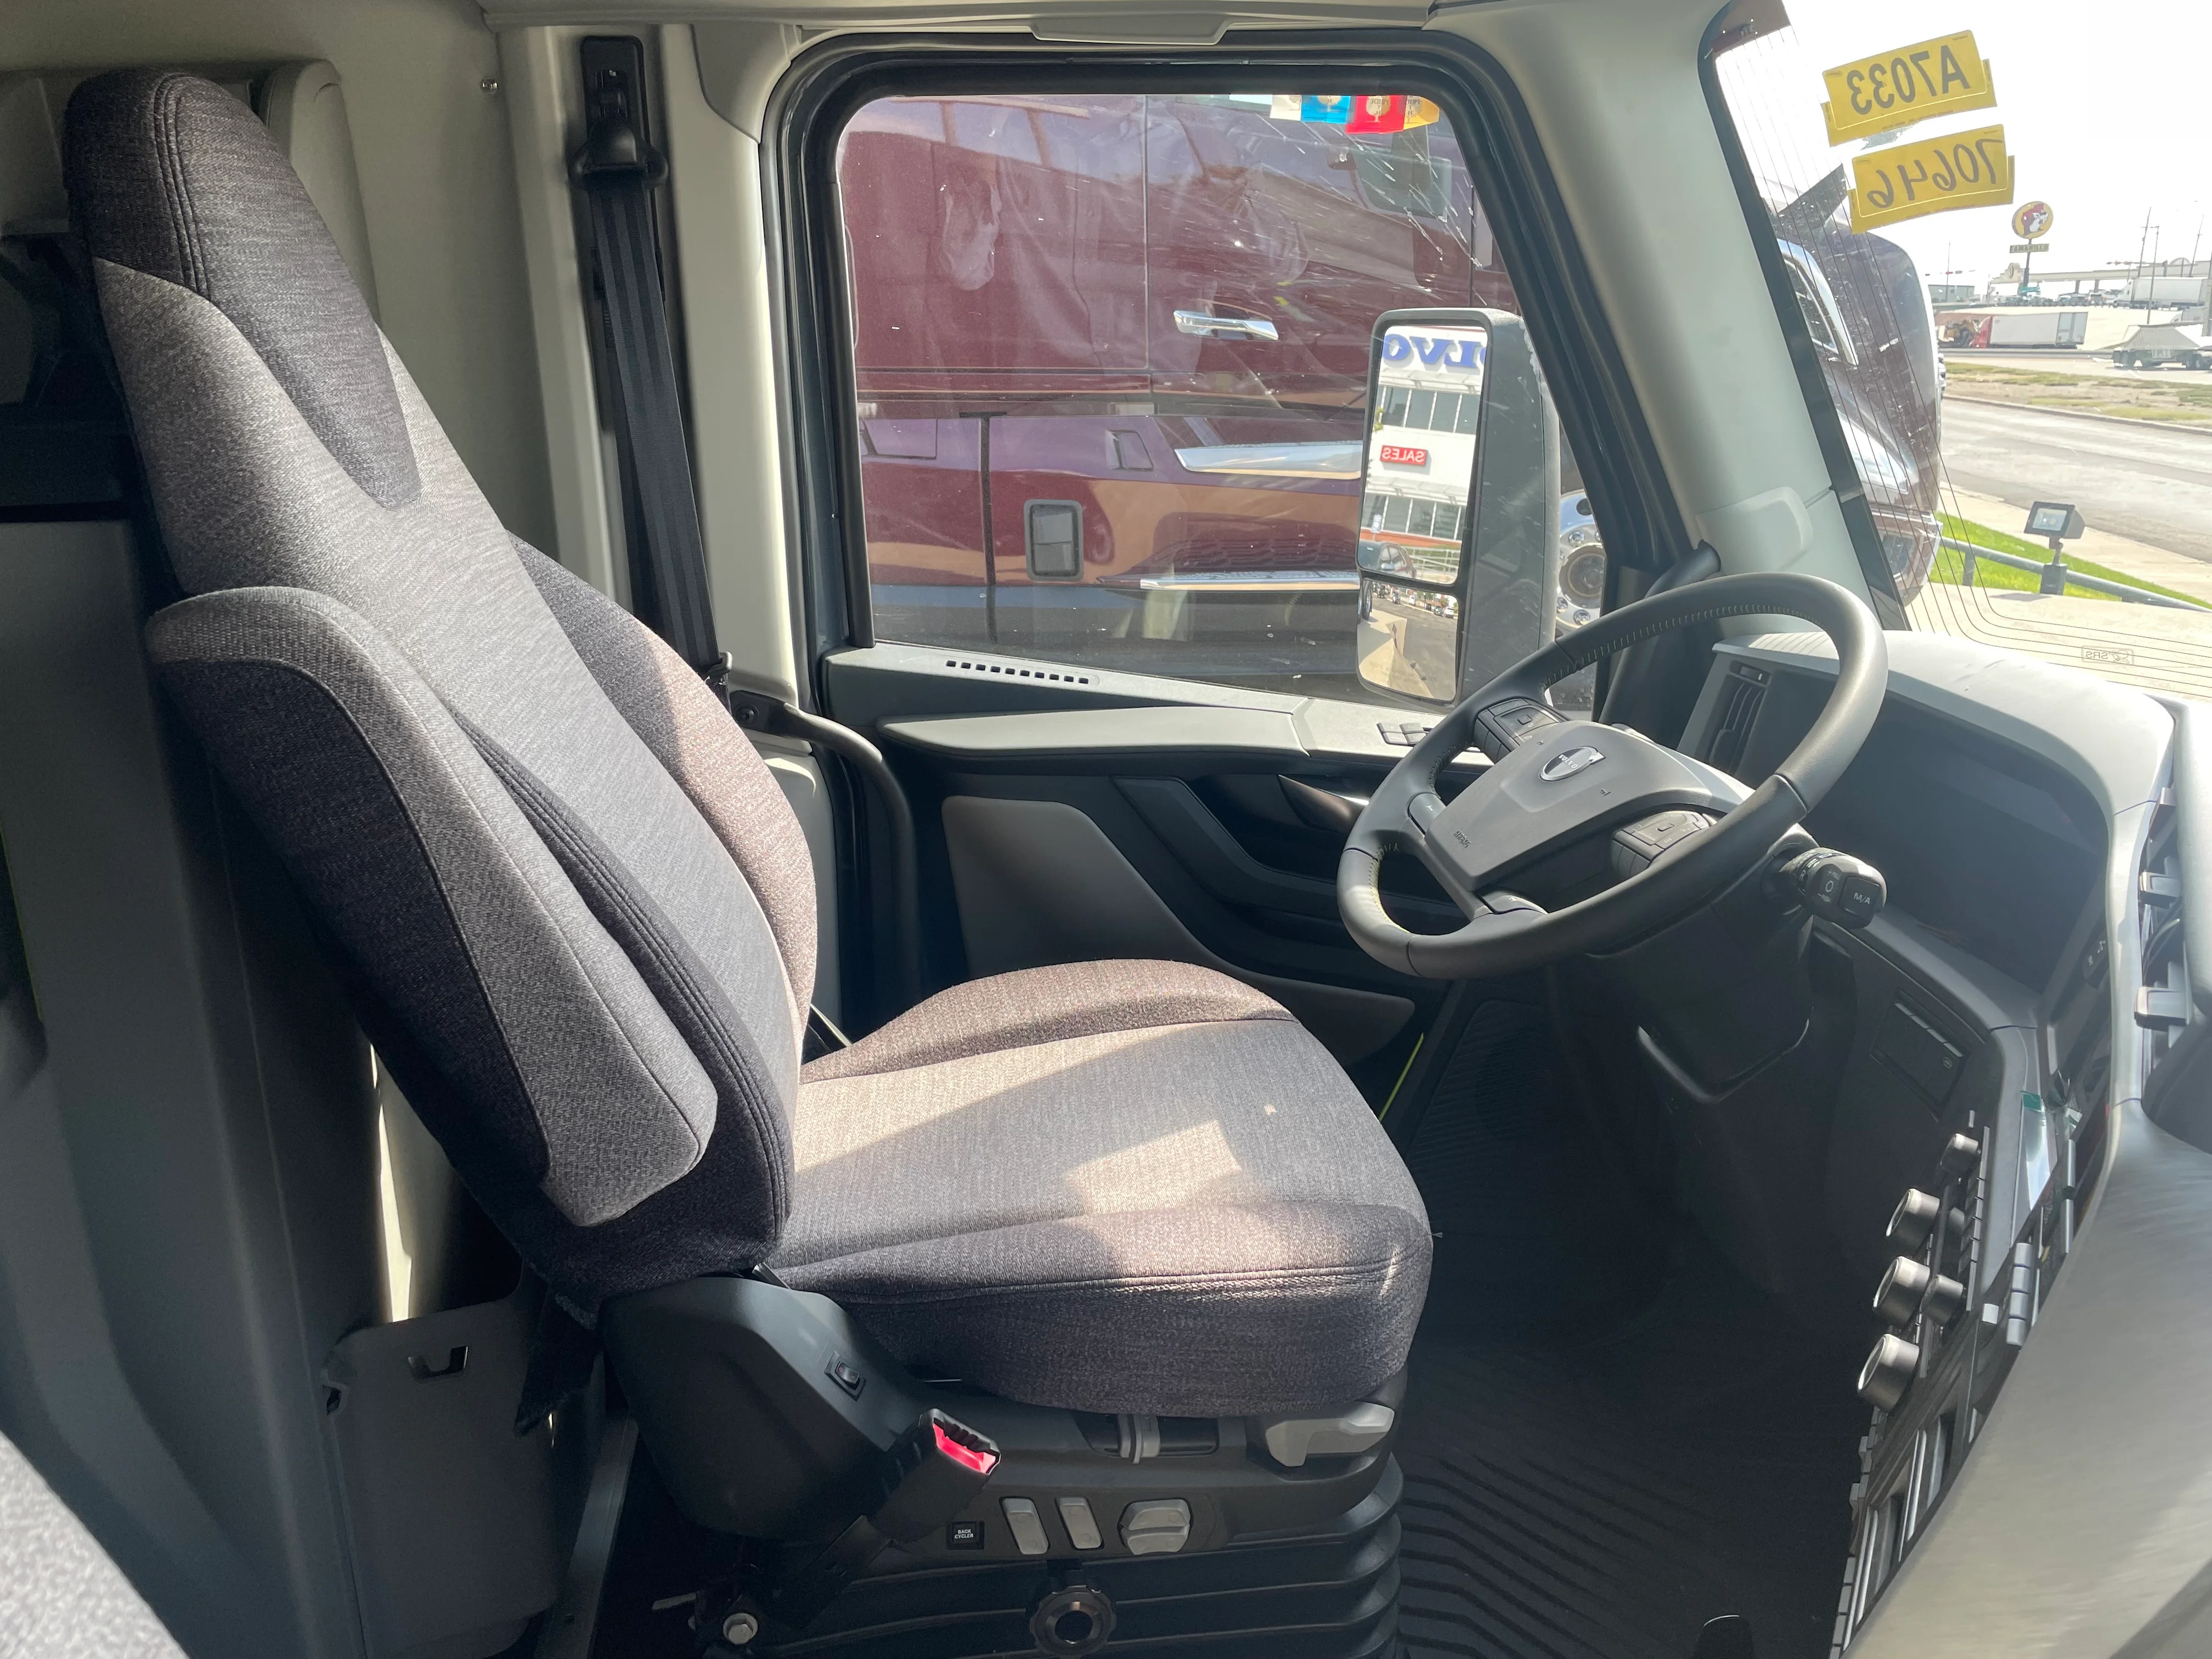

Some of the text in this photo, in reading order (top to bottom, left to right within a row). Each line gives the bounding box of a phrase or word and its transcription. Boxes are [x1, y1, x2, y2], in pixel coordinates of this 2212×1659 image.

[1558, 754, 1578, 769] VOLVO
[1453, 831, 1471, 848] AIRBAG
[1799, 870, 1806, 882] R
[1853, 892, 1871, 905] M/A
